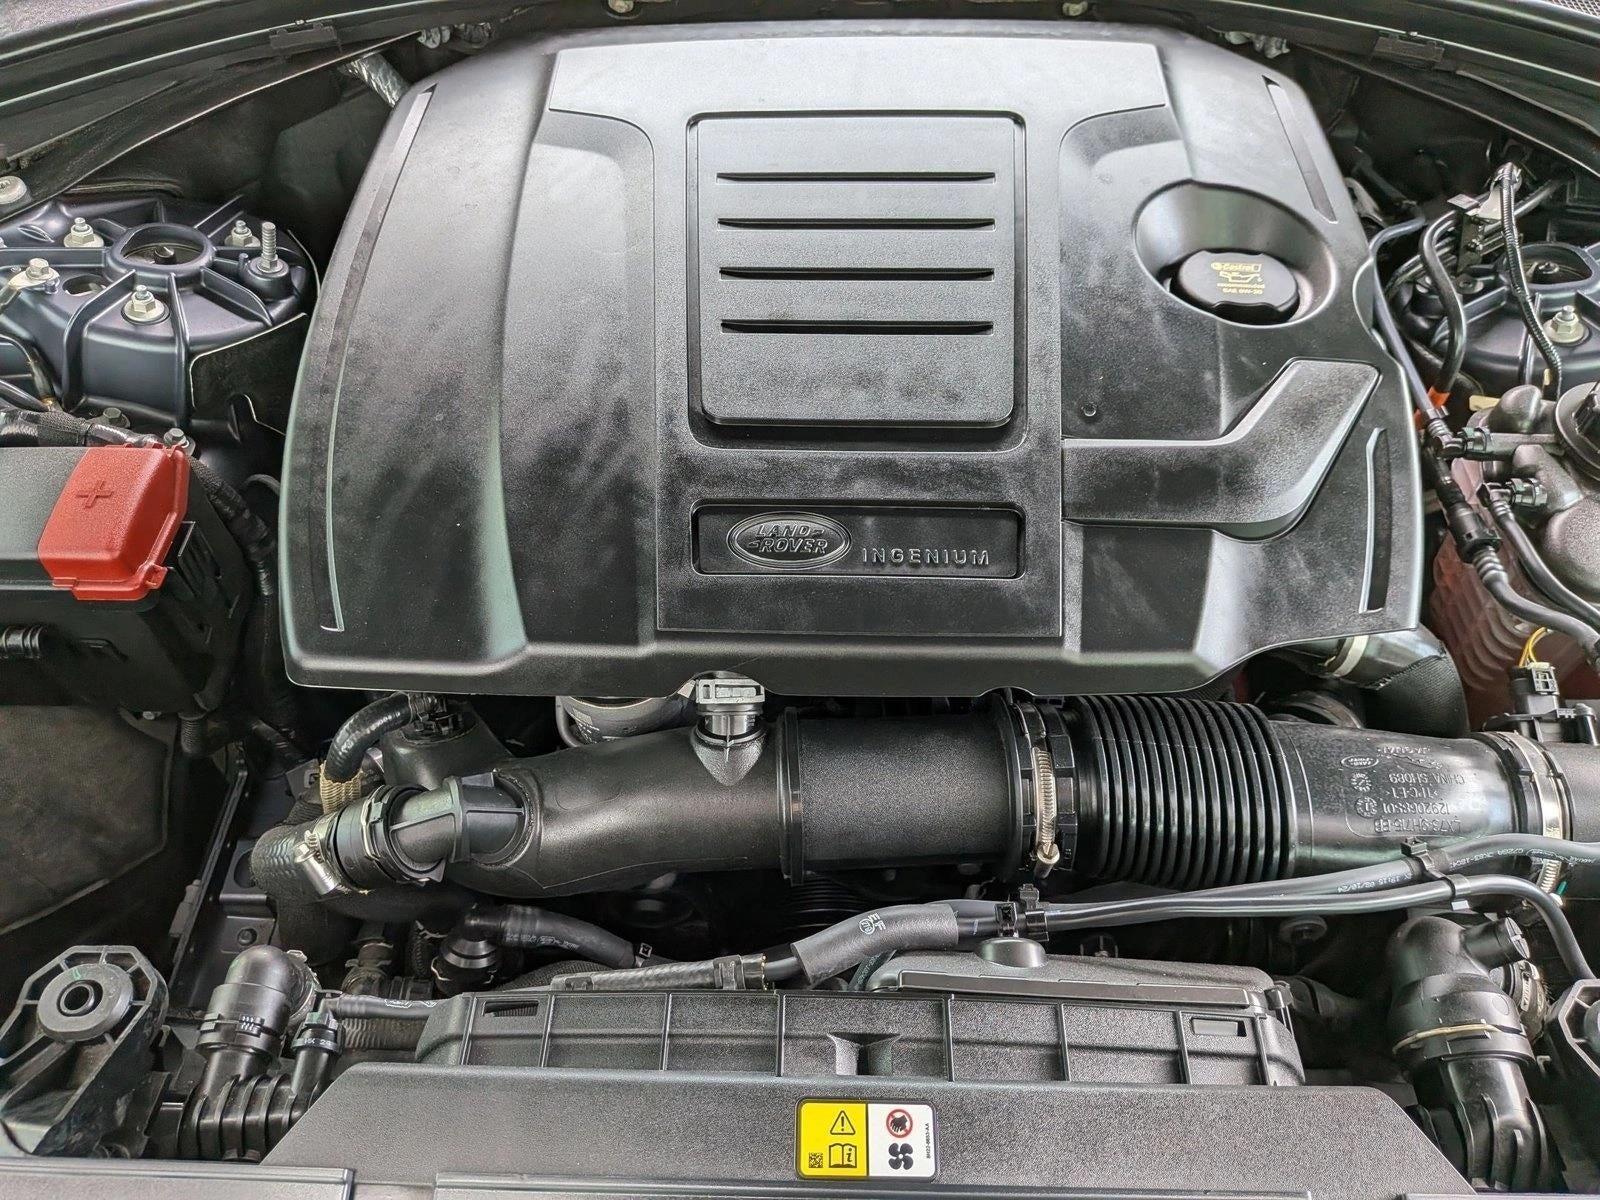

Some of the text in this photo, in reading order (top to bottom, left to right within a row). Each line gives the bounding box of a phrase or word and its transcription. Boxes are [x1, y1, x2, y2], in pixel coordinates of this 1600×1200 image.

[755, 523, 812, 537] LAND
[758, 538, 829, 554] ROVER
[862, 547, 990, 566] INGENIUM
